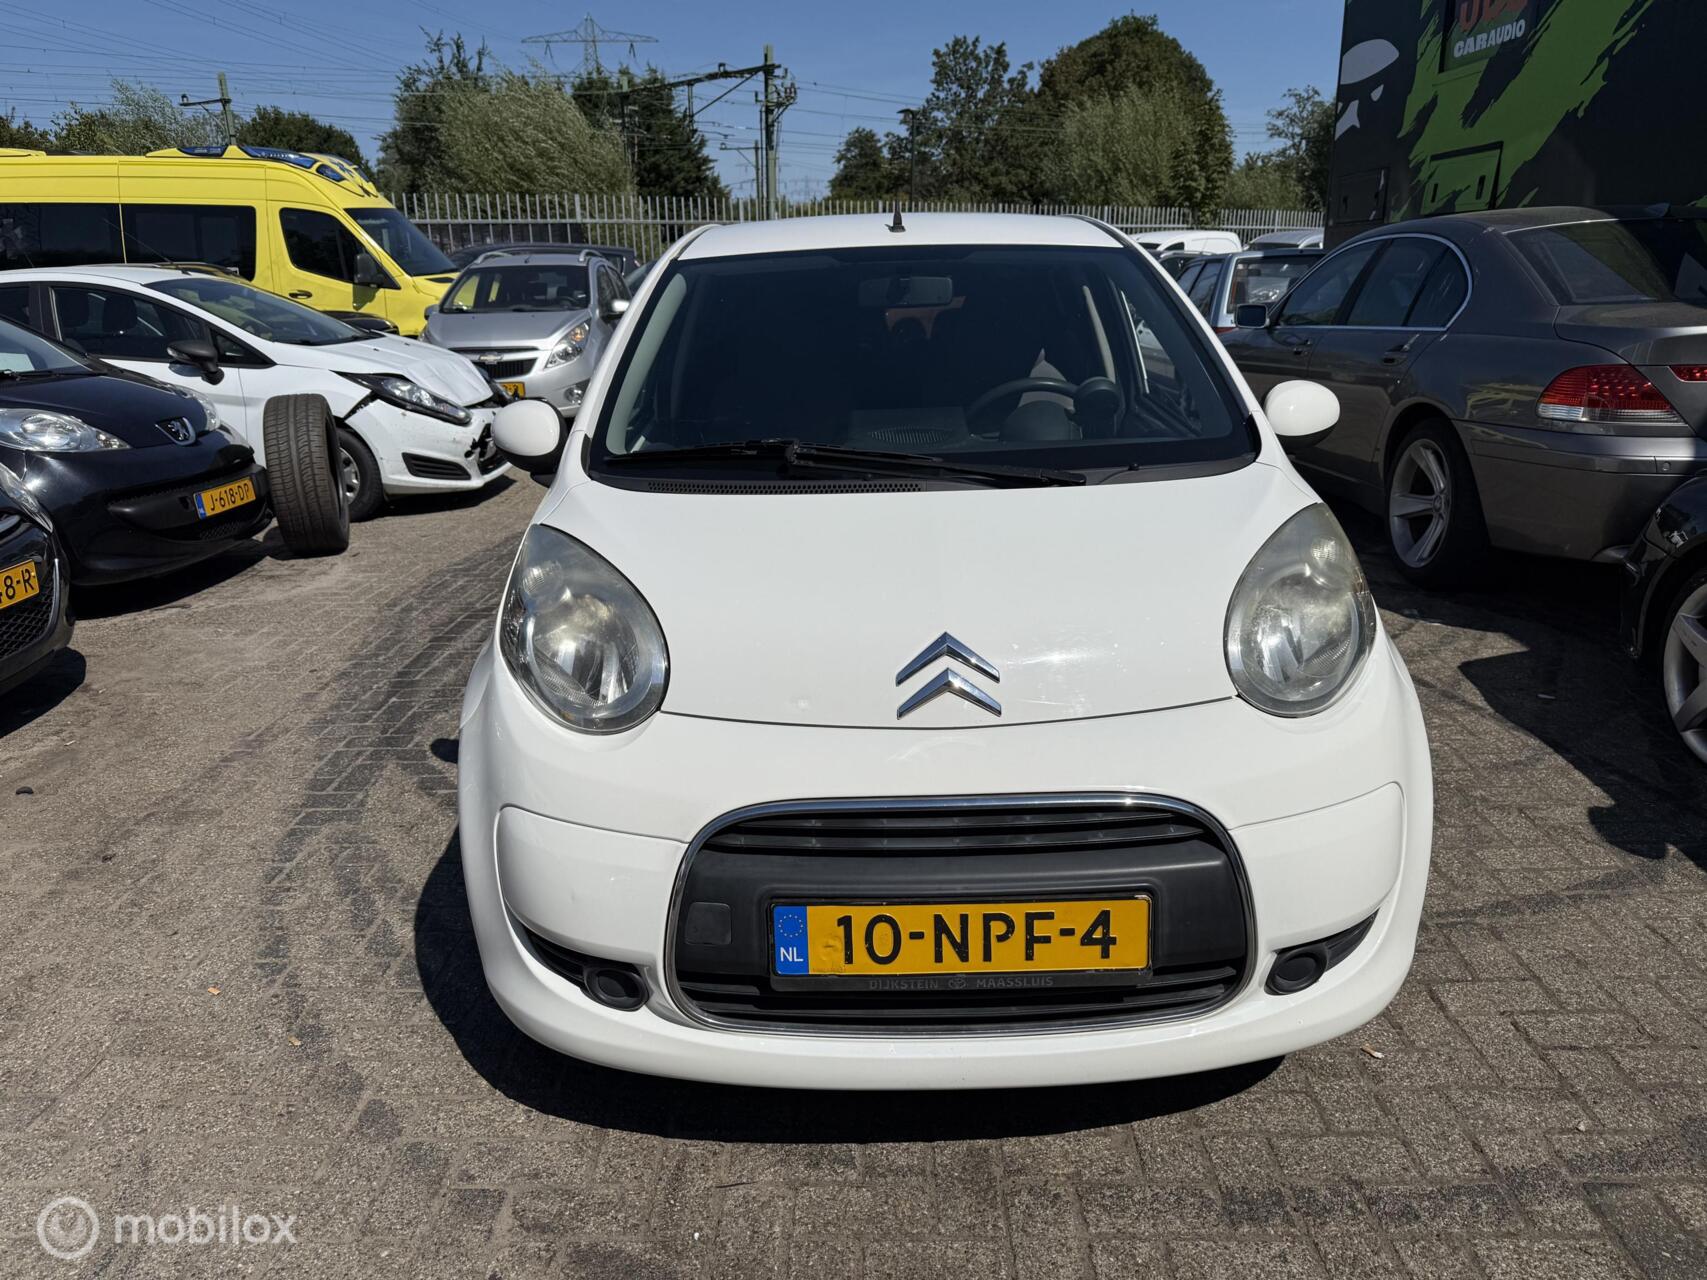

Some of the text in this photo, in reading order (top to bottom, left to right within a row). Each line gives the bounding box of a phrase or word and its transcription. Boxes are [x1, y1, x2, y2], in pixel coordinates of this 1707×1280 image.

[210, 483, 249, 511] J-618-DP
[836, 909, 1117, 965] 10-NPF-4
[779, 946, 804, 963] NL
[976, 976, 1054, 989] MAASSLUIS
